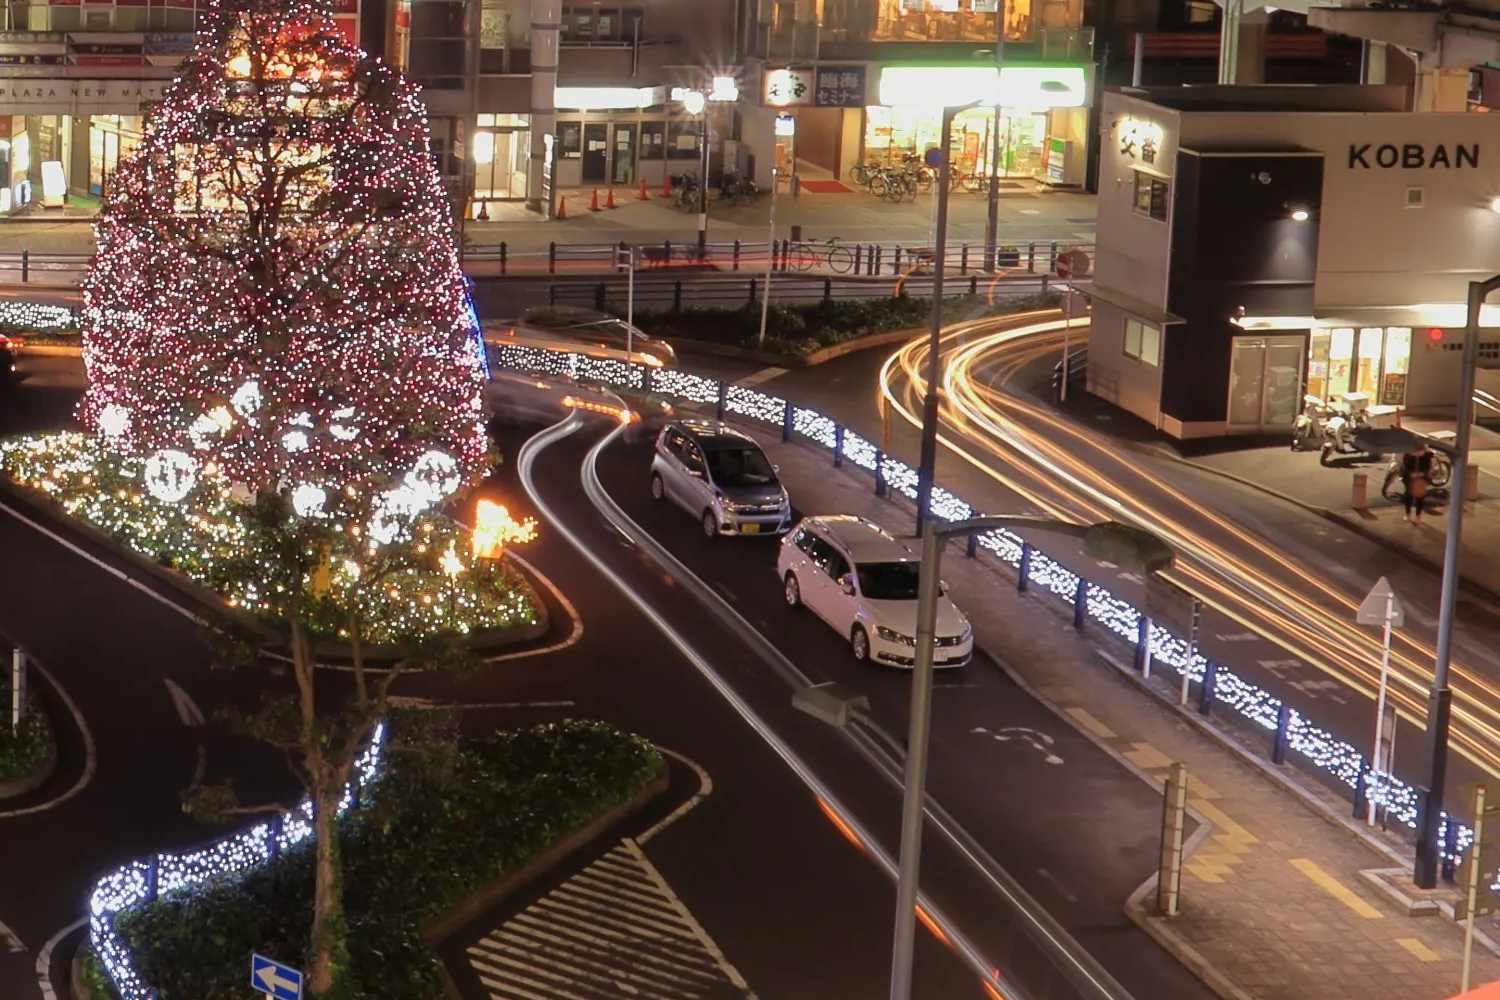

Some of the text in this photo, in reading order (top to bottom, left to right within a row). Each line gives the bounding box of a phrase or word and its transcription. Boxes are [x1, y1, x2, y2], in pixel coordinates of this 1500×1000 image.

[0, 88, 56, 97] PLAZA
[70, 88, 106, 97] NEW
[818, 89, 862, 105] セミナー
[1120, 127, 1157, 165] 交番
[1348, 143, 1481, 170] KOBAN
